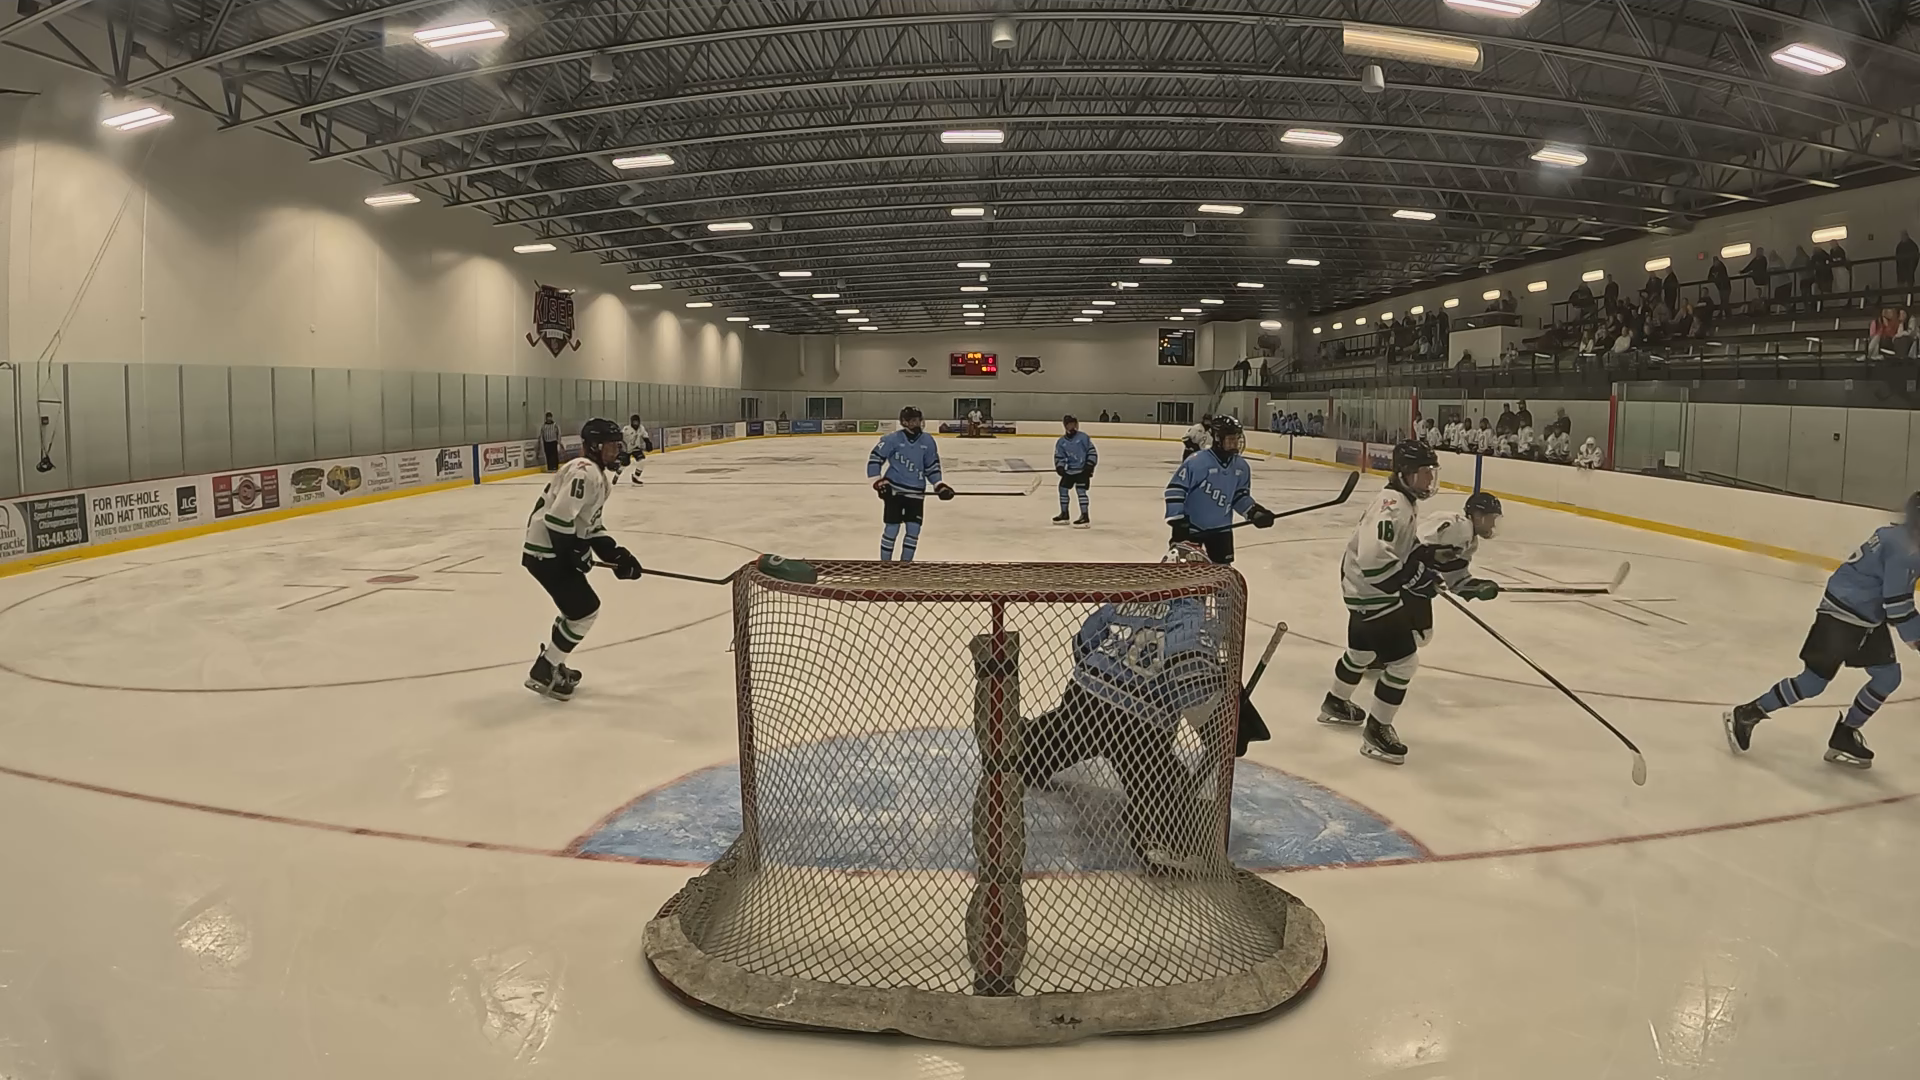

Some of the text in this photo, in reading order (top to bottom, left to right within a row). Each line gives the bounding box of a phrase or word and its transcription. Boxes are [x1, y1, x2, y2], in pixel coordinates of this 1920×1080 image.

[443, 449, 461, 460] First
[444, 459, 463, 471] Bank
[1178, 467, 1187, 481] 4
[570, 478, 585, 499] 15
[92, 490, 160, 512] FOR FIVE-HOLE
[181, 497, 197, 509] JLG
[94, 511, 115, 527] AND
[117, 508, 135, 523] HAT
[137, 503, 172, 520] TRICKS,
[36, 527, 83, 549] 763-441-3830
